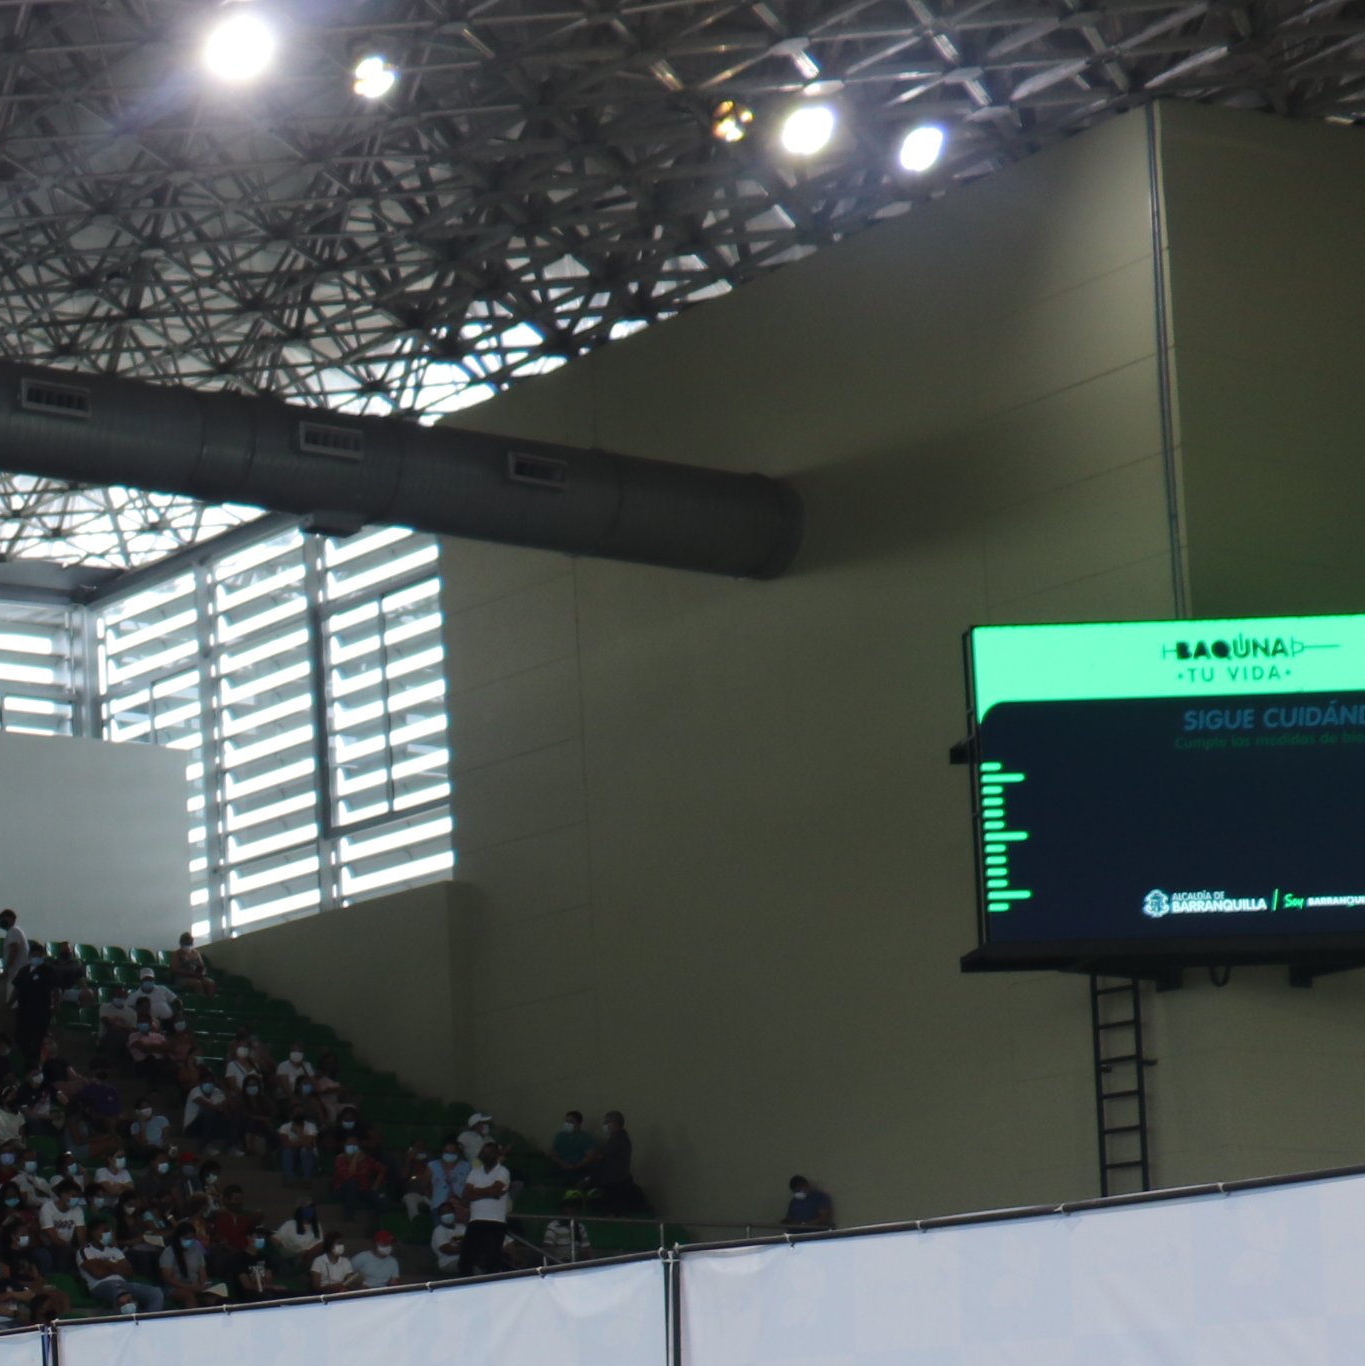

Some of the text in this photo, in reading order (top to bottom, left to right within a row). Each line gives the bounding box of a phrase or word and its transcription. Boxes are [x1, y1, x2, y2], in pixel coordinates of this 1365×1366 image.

[1187, 665, 1281, 682] TU VIDA
[1183, 708, 1256, 731] SIGUE
[1171, 889, 1225, 901] ALCALDÍA DE
[1171, 898, 1267, 913] BARRANQUILLA
